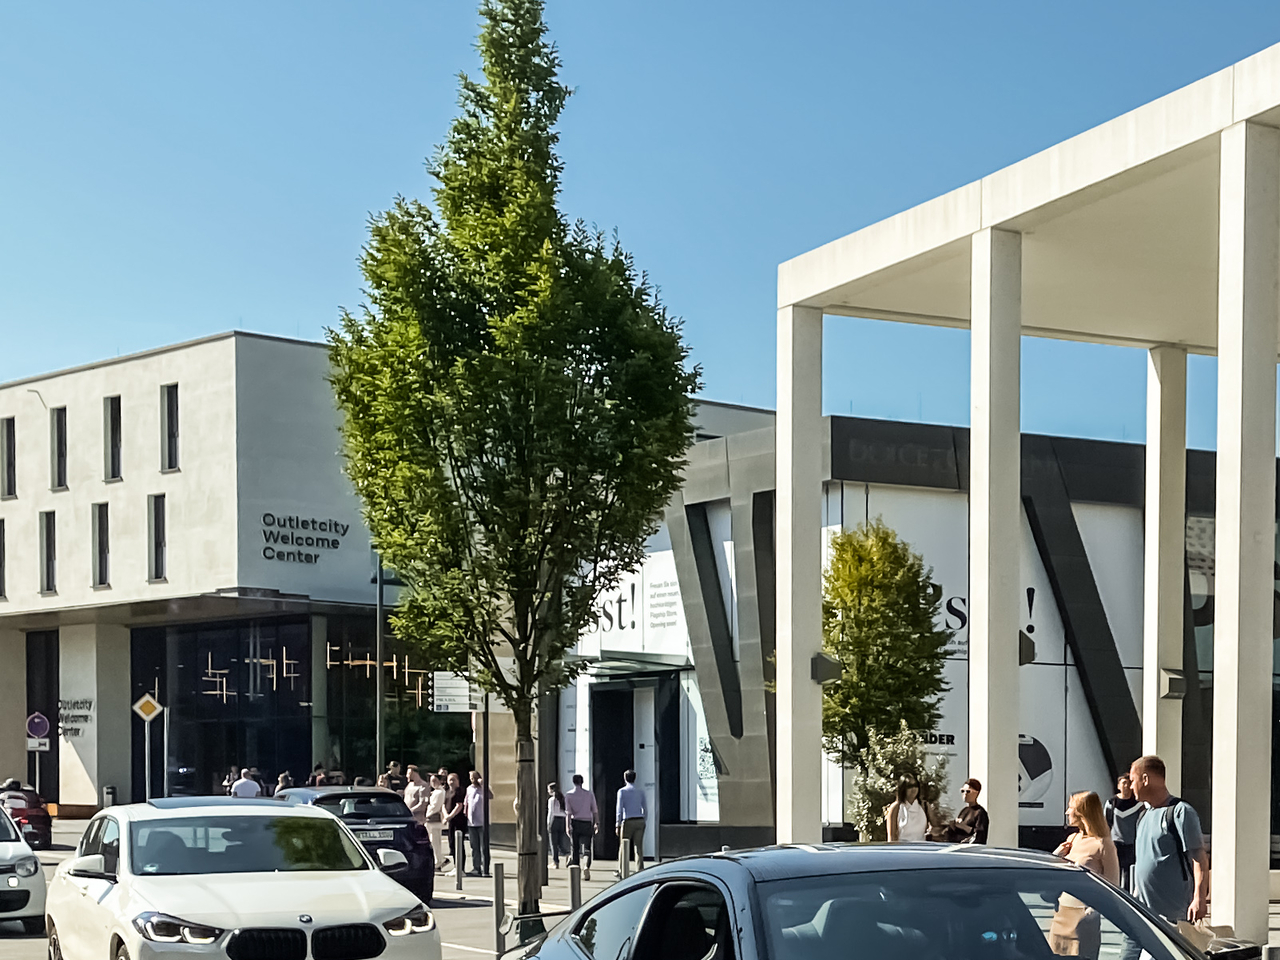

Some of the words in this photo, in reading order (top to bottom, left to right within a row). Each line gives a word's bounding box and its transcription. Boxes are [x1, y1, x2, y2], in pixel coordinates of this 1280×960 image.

[261, 512, 350, 537] Outletcity
[261, 529, 341, 549] Welcome
[261, 546, 321, 564] Center
